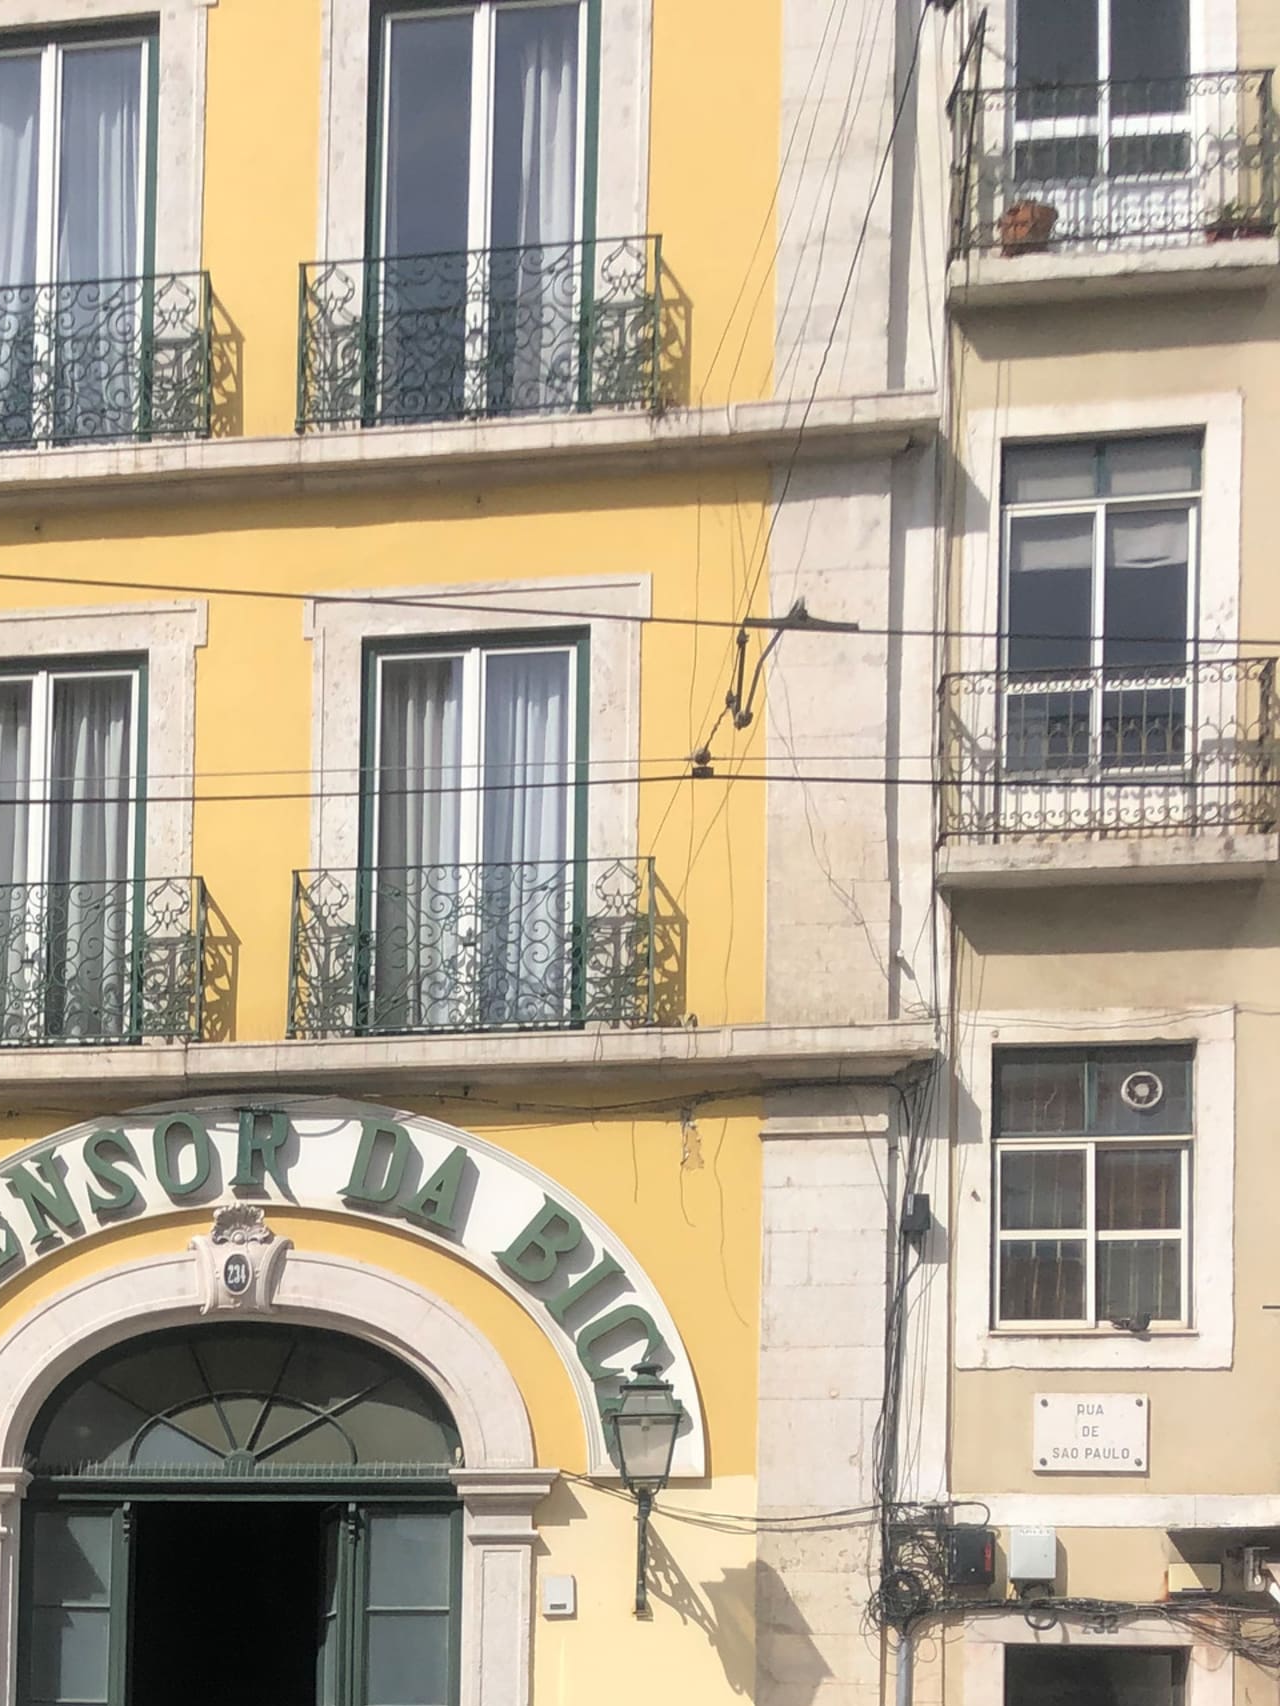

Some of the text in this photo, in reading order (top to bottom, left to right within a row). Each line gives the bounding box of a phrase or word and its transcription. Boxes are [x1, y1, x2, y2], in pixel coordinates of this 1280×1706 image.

[344, 1118, 468, 1235] DA
[227, 1264, 246, 1284] 234
[1076, 1403, 1104, 1416] RUA
[1081, 1425, 1099, 1437] DE
[1084, 1447, 1130, 1459] PAULO
